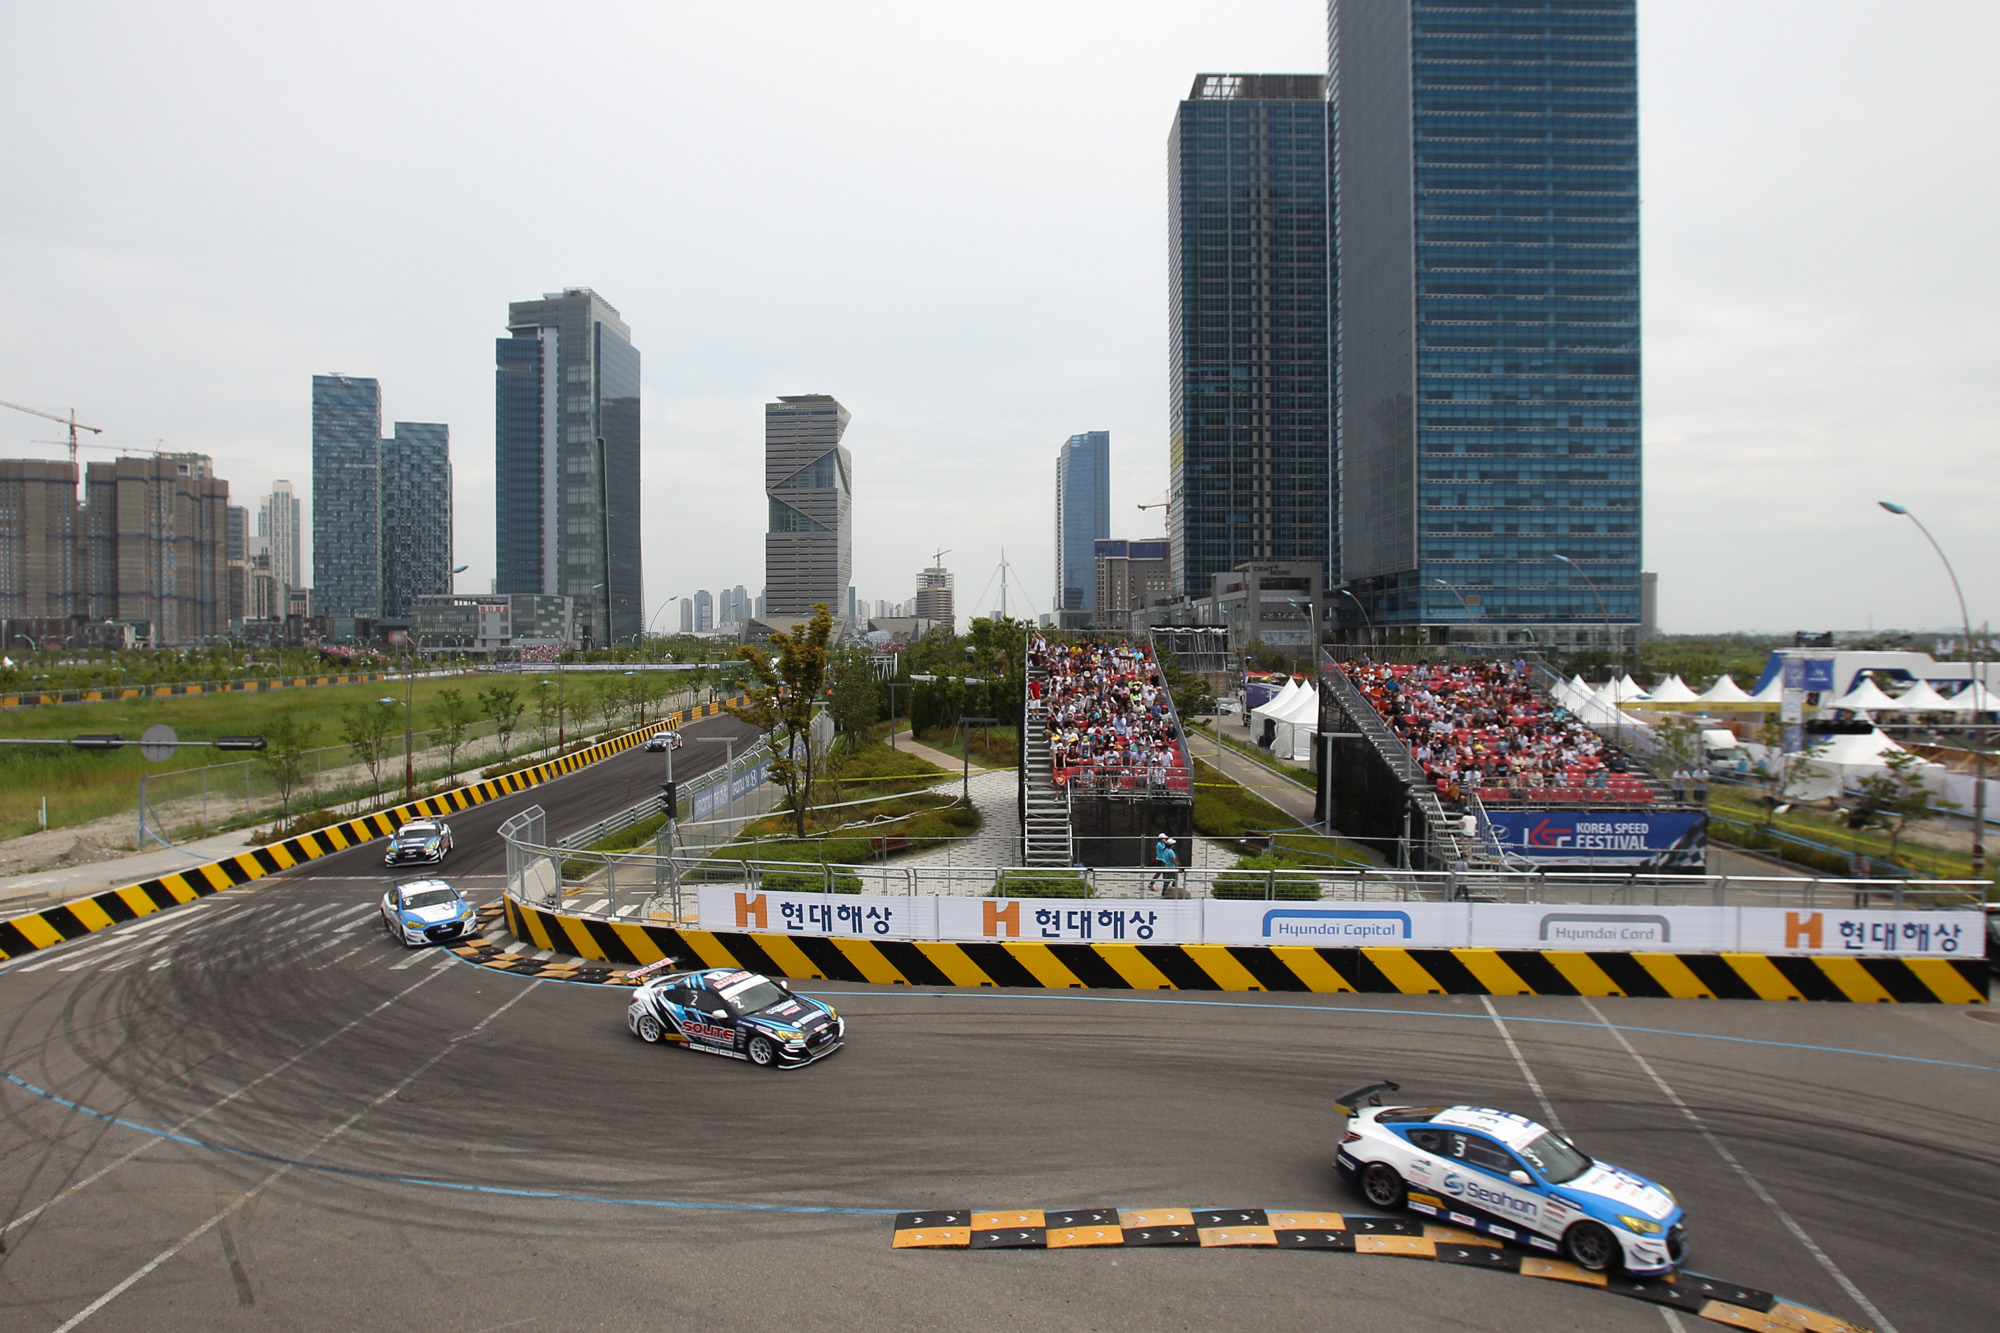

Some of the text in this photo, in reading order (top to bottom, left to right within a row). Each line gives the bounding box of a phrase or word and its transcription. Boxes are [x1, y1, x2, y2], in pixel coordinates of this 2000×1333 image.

[1576, 822, 1648, 834] KOREA SPEED
[1576, 835, 1648, 850] FESTIVAL
[780, 902, 892, 934] 현대해상
[1035, 908, 1158, 940] 현대해상
[1279, 922, 1396, 938] Hyundai Capital
[1556, 927, 1654, 942] Hyundai Card
[1839, 921, 1962, 952] 현대해상
[690, 994, 698, 1006] 2
[734, 1000, 744, 1010] 2
[682, 1020, 734, 1040] SOLITE
[1454, 1141, 1466, 1158] 3
[1466, 1182, 1537, 1216] Seohan
